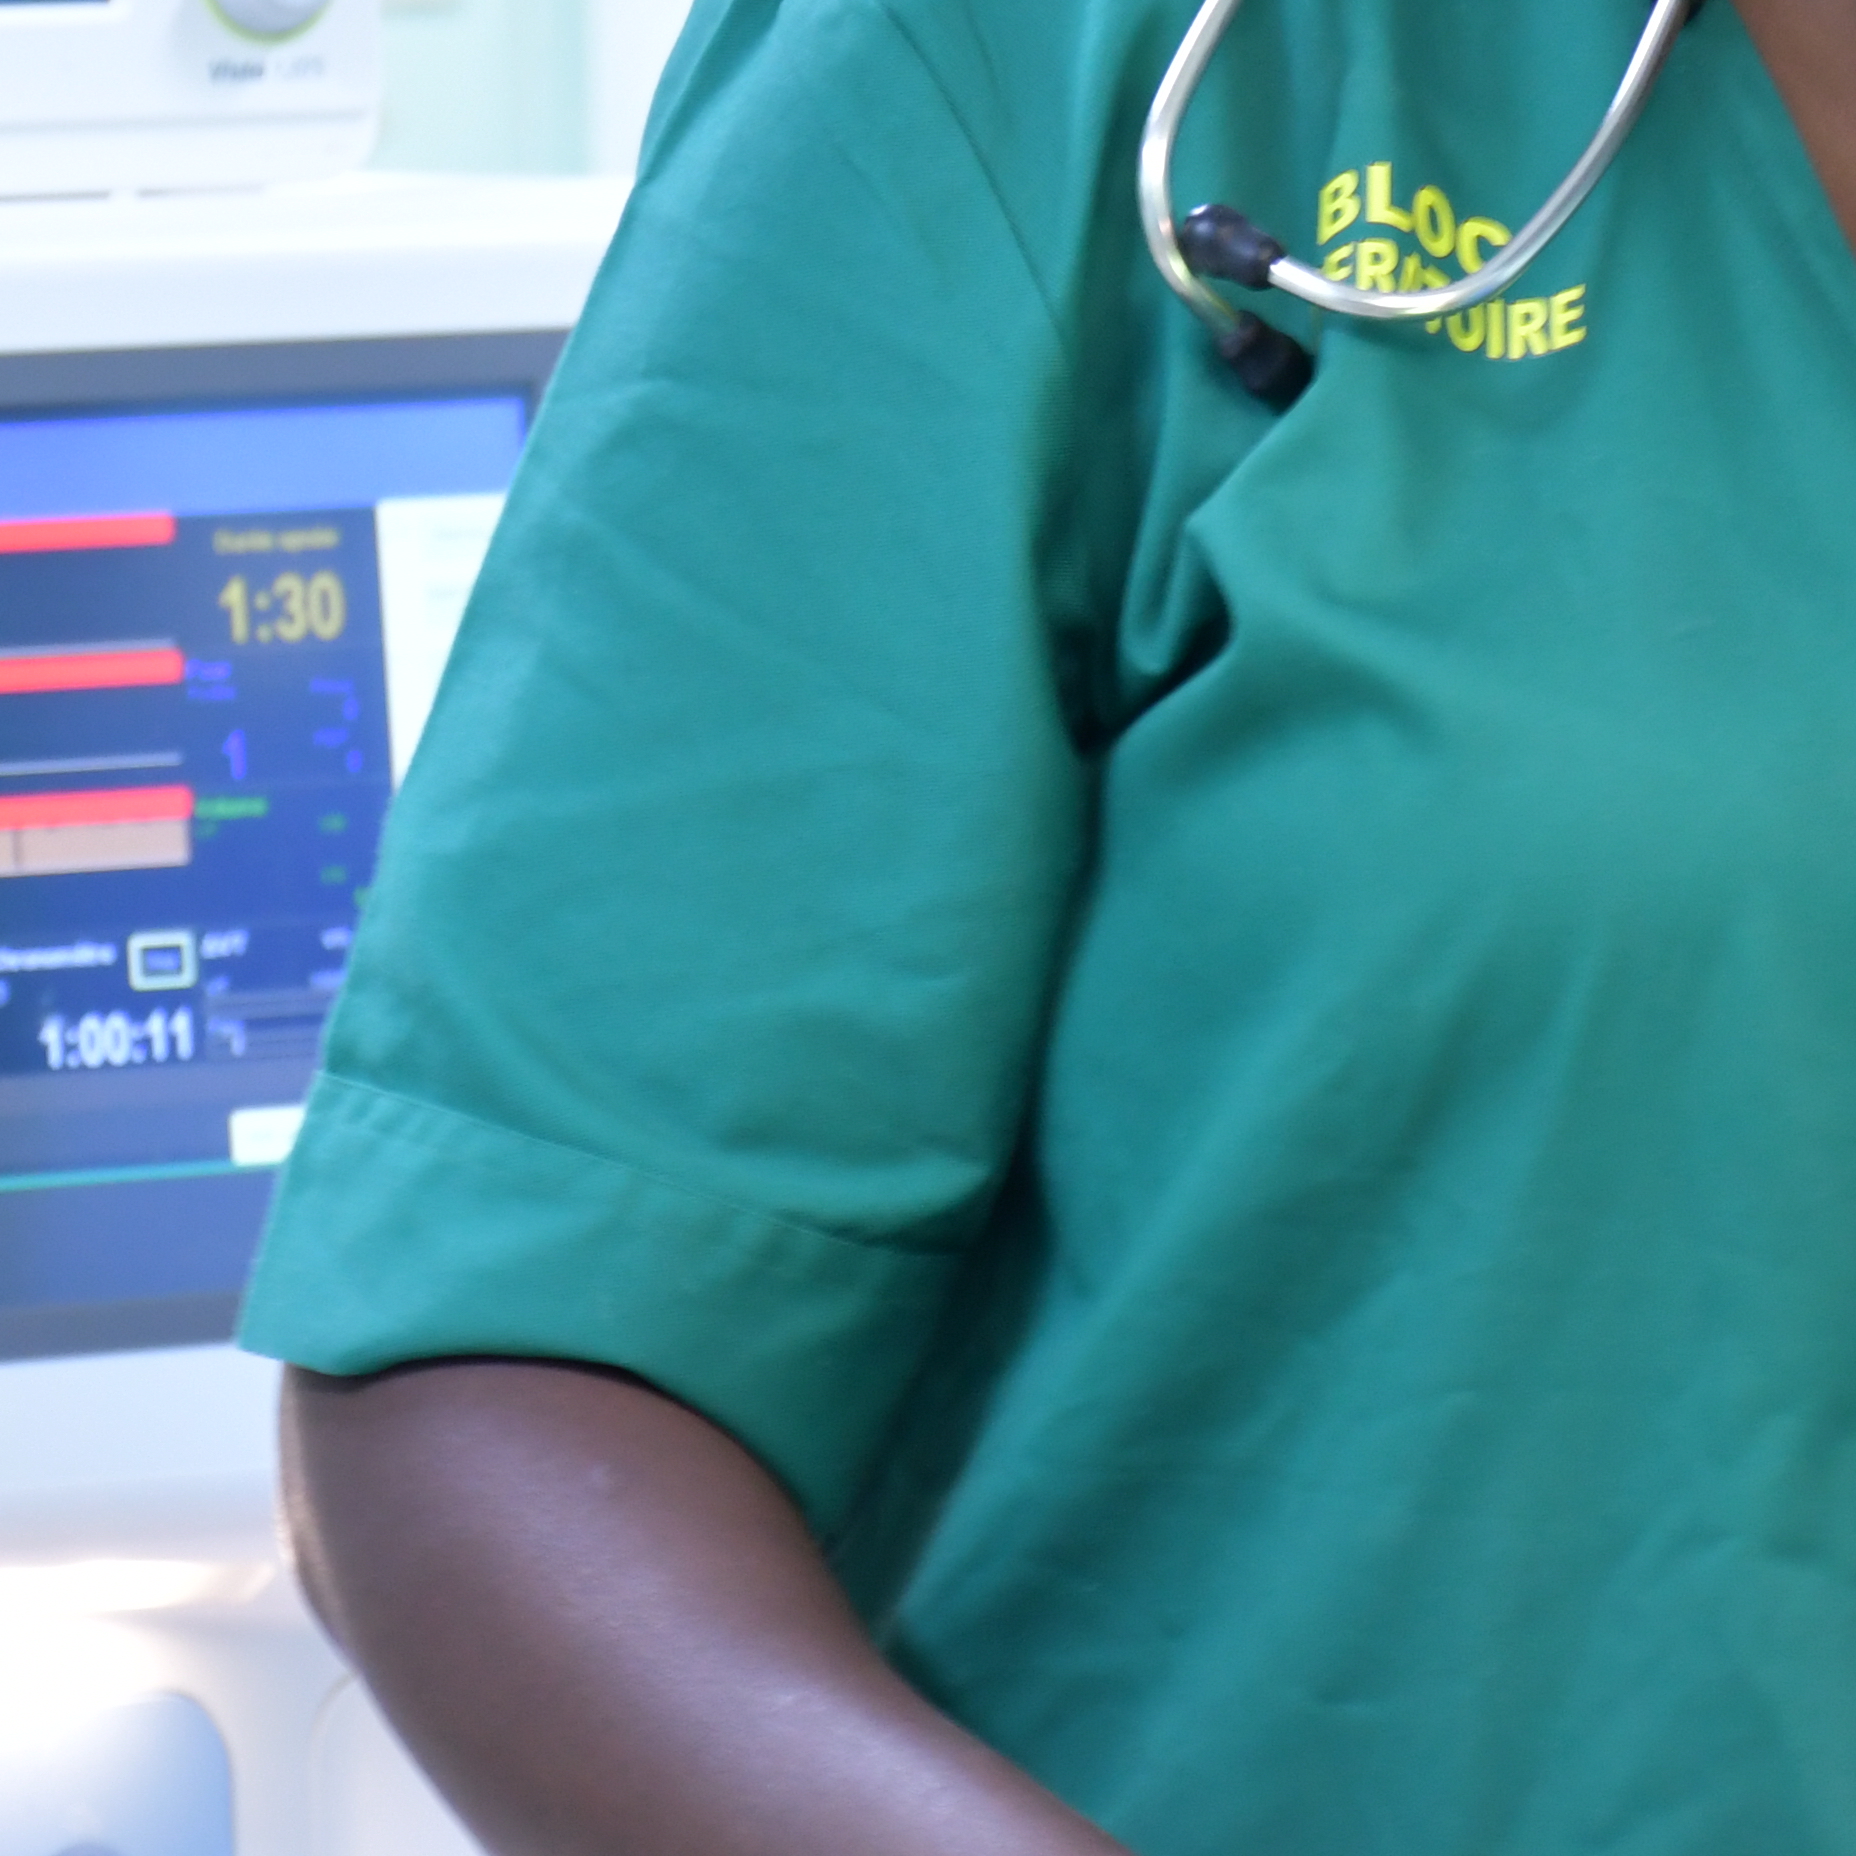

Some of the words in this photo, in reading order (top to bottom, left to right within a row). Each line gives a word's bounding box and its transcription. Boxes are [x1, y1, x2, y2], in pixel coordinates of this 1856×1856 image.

[1317, 161, 1513, 276] BLOC
[218, 569, 347, 644] 1:30
[38, 1005, 195, 1071] 1:00:11
